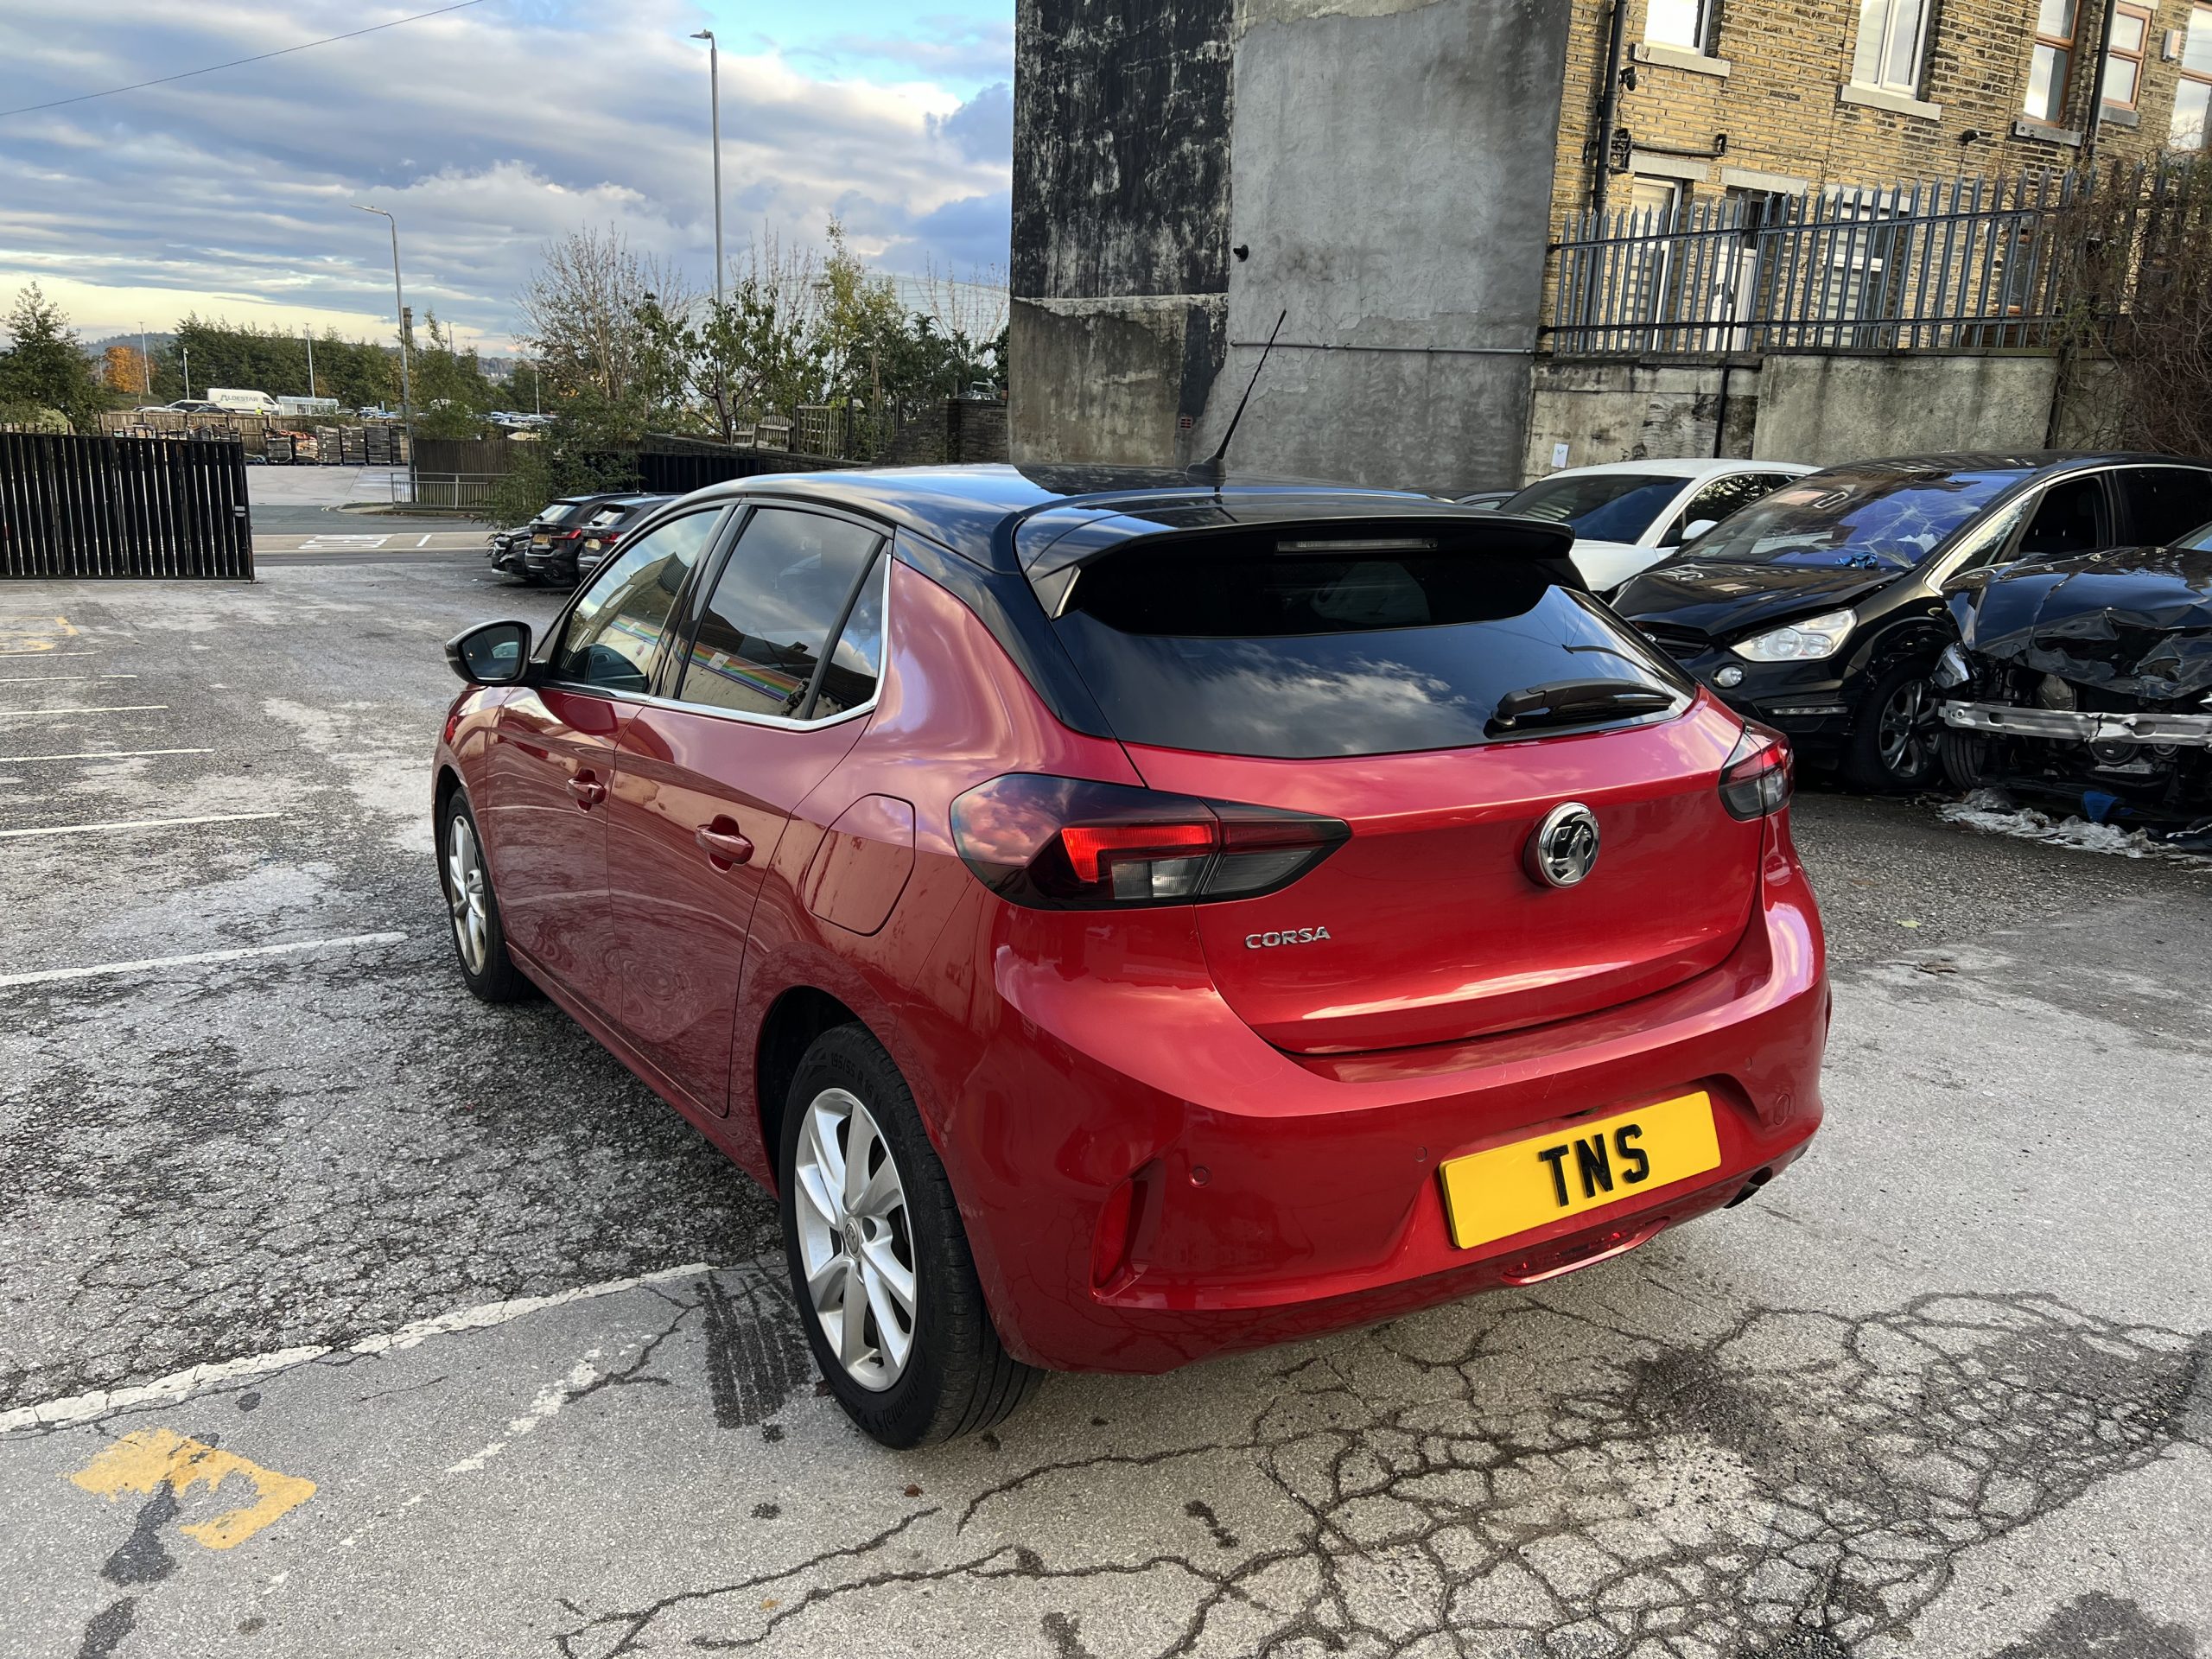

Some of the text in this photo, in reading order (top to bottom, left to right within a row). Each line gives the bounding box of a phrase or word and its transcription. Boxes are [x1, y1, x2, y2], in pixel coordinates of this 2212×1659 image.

[1245, 926, 1331, 949] CORSA
[831, 1052, 855, 1078] 195/55
[1539, 1124, 1649, 1207] TNS
